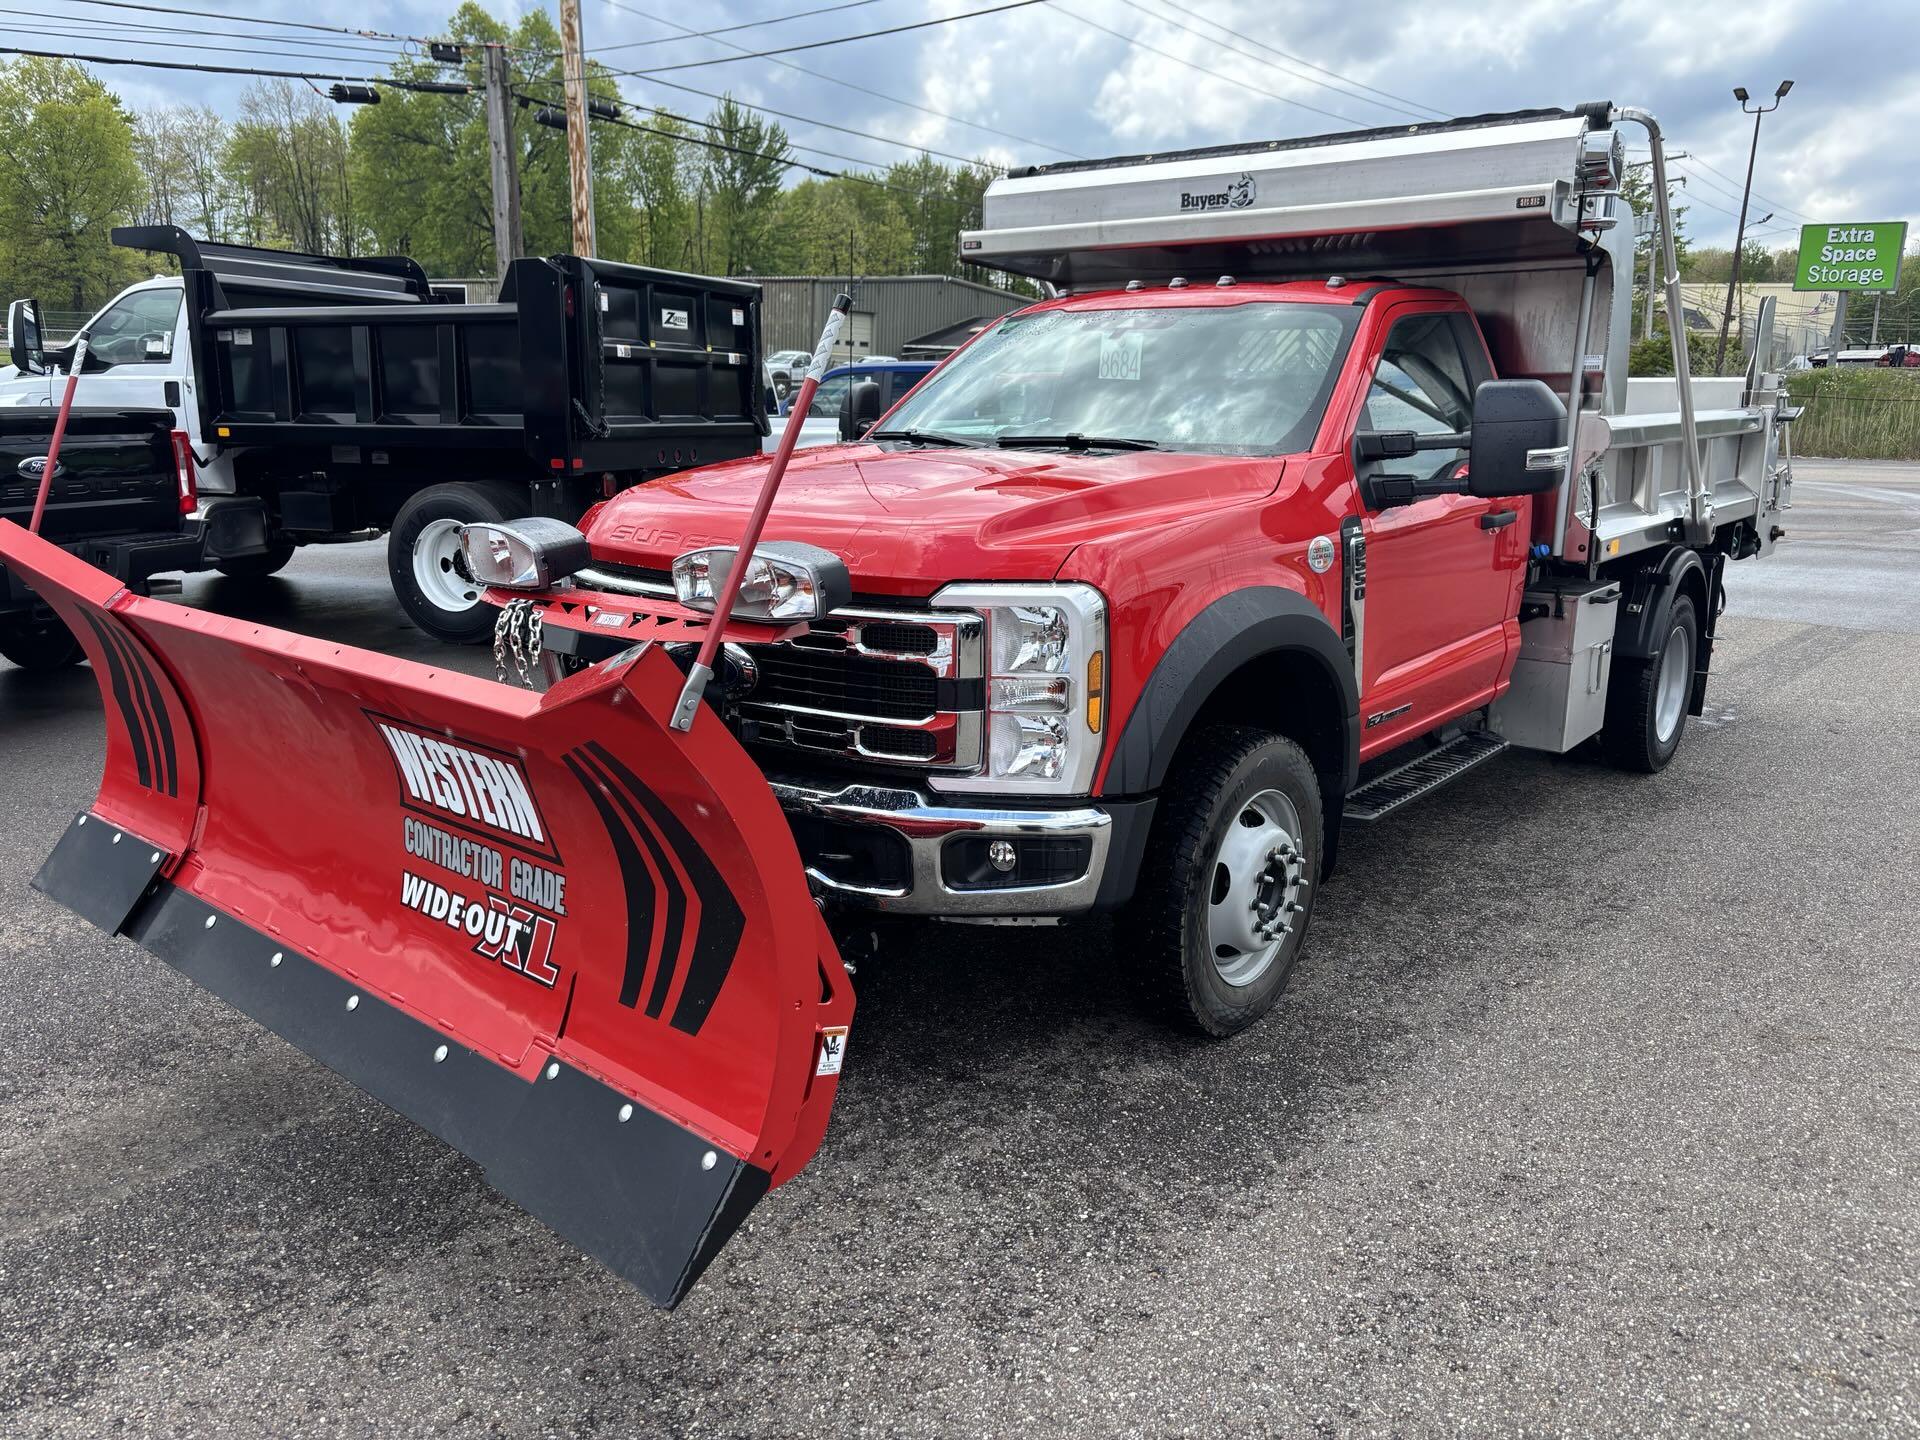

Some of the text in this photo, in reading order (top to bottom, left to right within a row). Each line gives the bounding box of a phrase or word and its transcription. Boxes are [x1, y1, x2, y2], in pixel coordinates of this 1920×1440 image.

[1181, 193, 1229, 210] Buyers
[1827, 227, 1875, 243] Extra
[1821, 245, 1877, 266] Space
[1808, 265, 1884, 285] Storage
[1101, 350, 1138, 379] 8684
[1353, 526, 1362, 534] XL
[379, 723, 545, 843] WESTERN
[404, 816, 567, 916] CONTRACTOR GRADE
